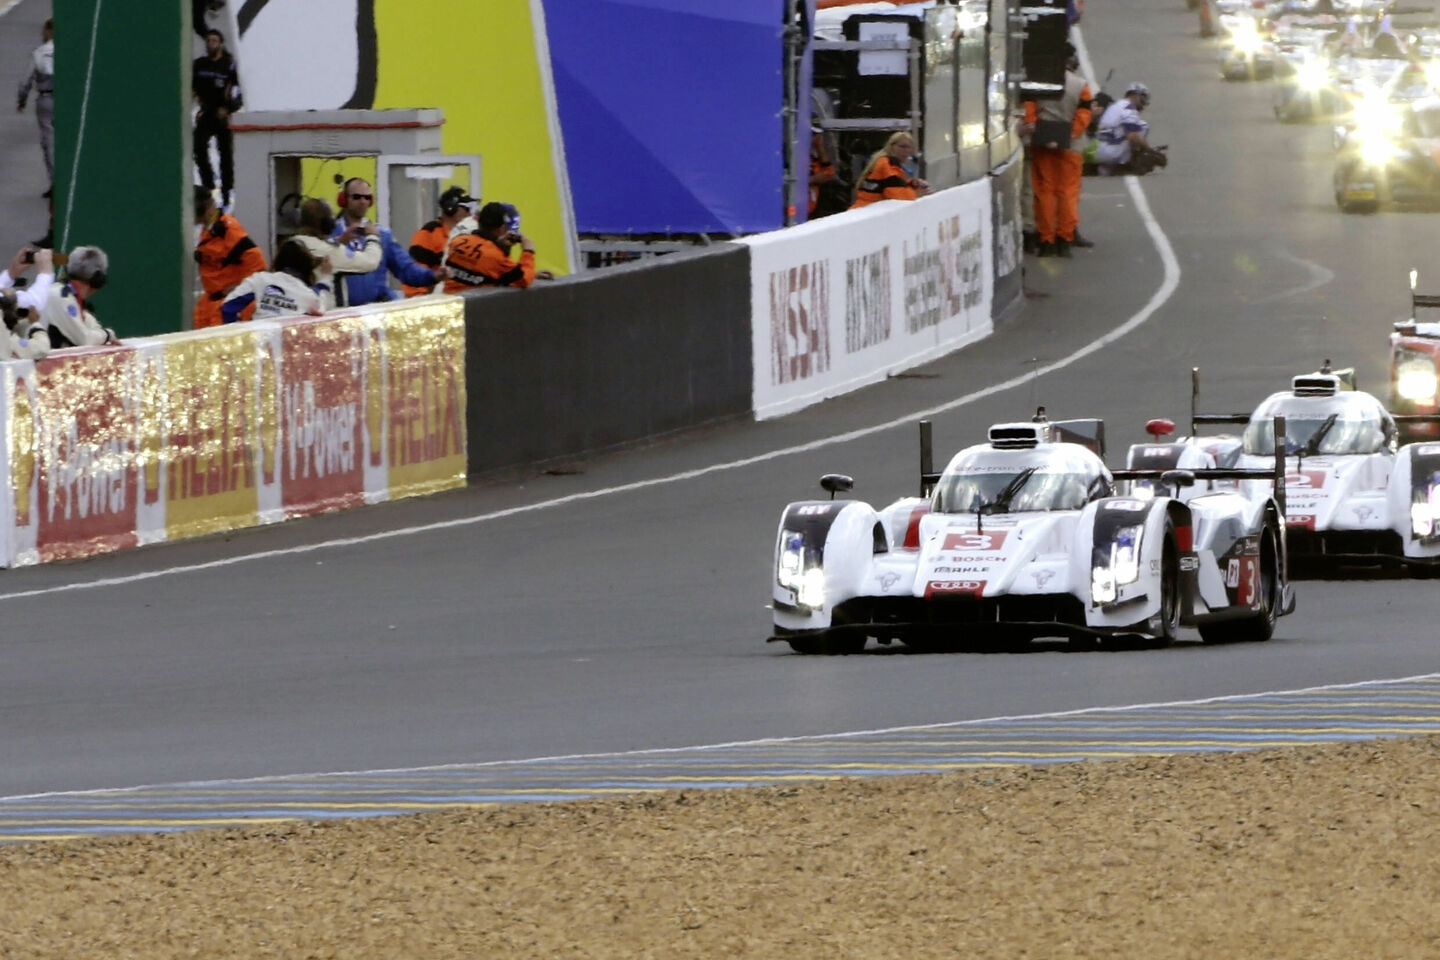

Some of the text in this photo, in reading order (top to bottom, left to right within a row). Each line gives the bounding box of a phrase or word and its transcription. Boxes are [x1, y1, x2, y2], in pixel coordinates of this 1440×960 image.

[768, 257, 831, 387] NISSAN
[285, 379, 357, 481] V-Power
[388, 344, 464, 468] HELIX
[953, 533, 993, 550] 3
[1246, 560, 1256, 605] 3
